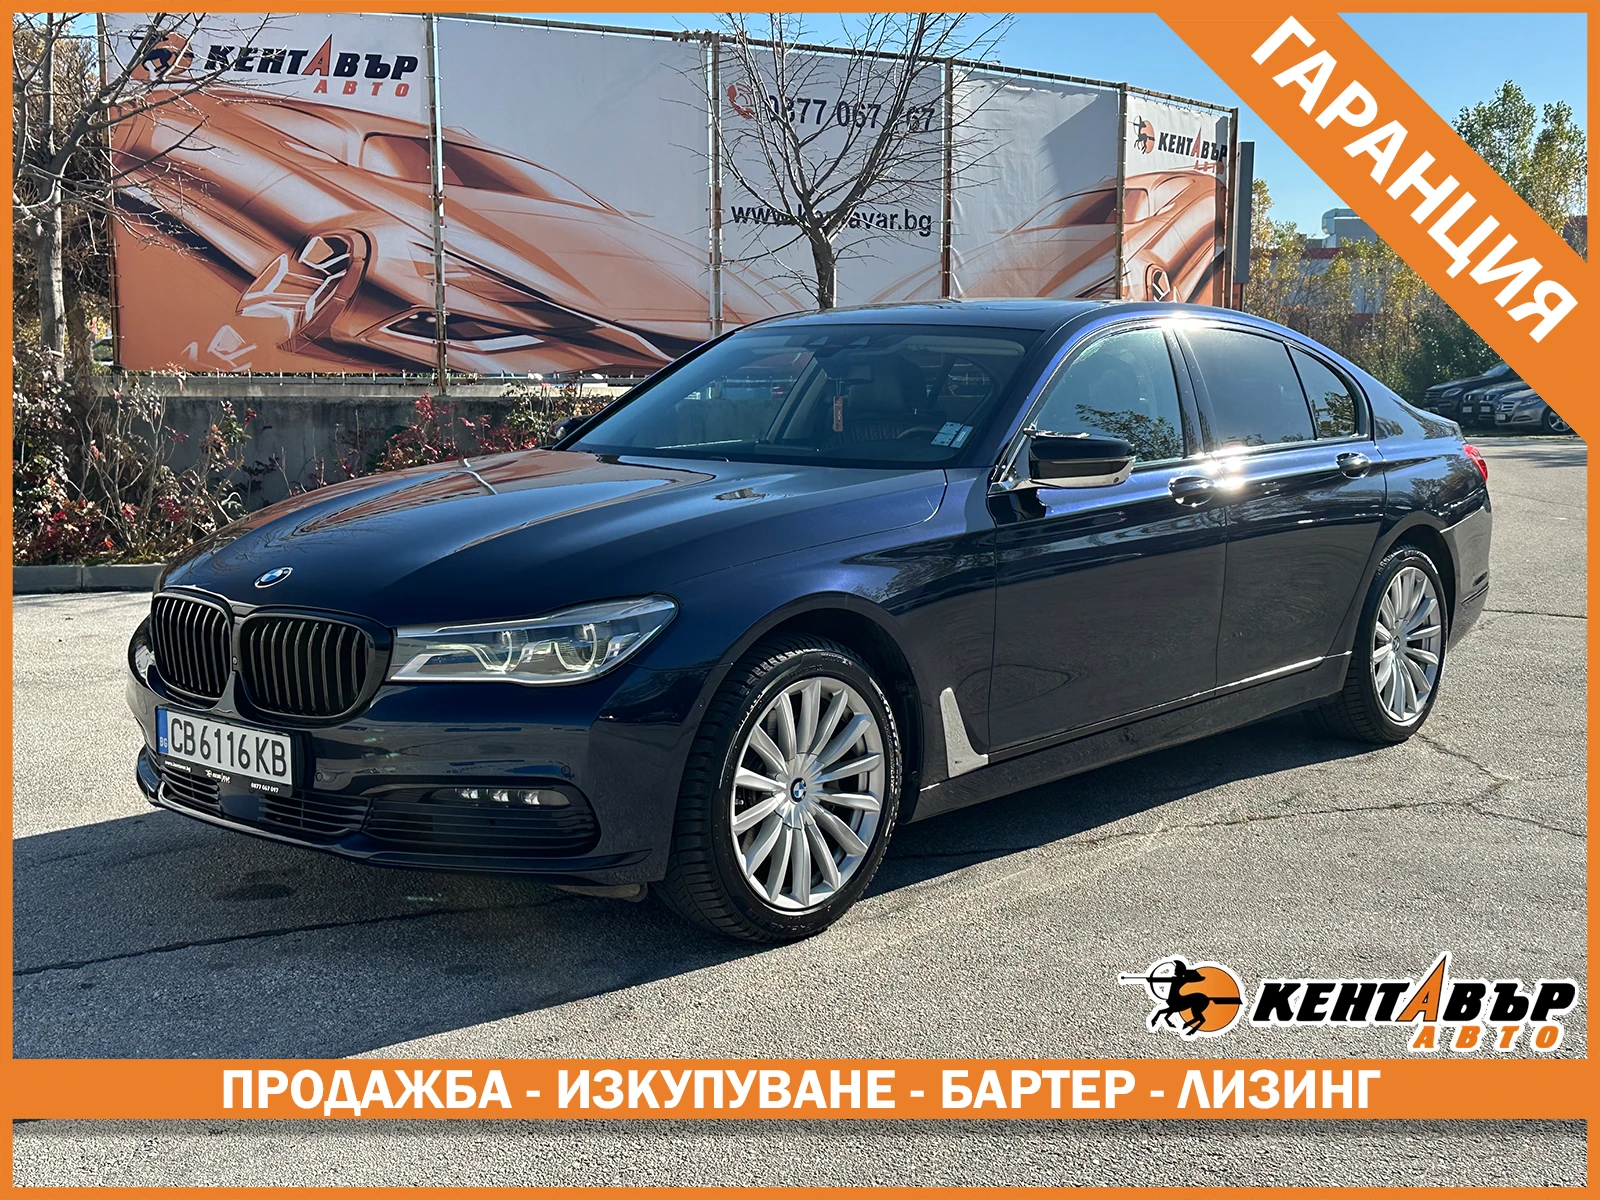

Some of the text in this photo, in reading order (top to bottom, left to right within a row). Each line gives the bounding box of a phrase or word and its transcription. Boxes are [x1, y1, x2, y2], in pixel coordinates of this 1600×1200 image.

[204, 34, 419, 80] КЕНТАВЪР
[313, 79, 410, 97] АВТО
[836, 100, 881, 128] 067
[1158, 127, 1228, 162] КЕНТАВЪР
[731, 204, 932, 237] wwwkavar.bg
